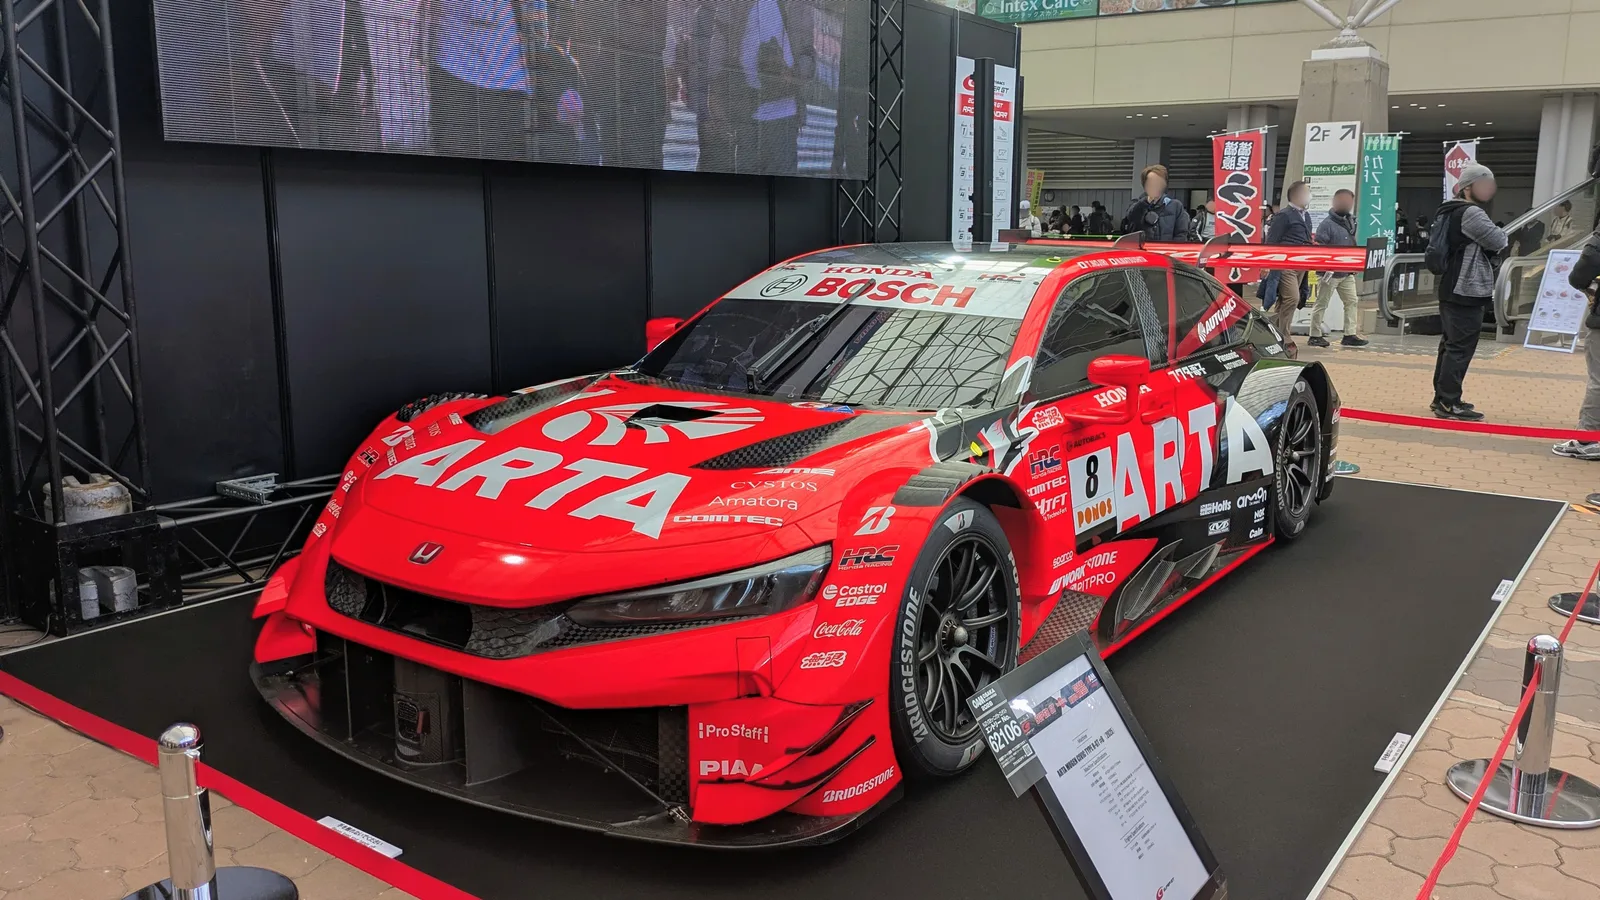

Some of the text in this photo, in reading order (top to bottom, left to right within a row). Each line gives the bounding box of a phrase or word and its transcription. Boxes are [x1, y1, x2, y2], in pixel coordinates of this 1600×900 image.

[1309, 125, 1331, 142] 2F
[1313, 165, 1330, 173] Intex
[1332, 164, 1348, 172] Cafe
[1366, 249, 1386, 270] ARTA
[820, 266, 934, 280] HONDA
[803, 277, 976, 309] BOSCH
[1206, 296, 1237, 335] AUTOBACS
[1094, 384, 1152, 408] HONA
[1074, 432, 1107, 448] AUTOBACS
[1028, 445, 1062, 476] HRC
[1115, 396, 1274, 534] ARTA
[754, 467, 836, 477] AME
[1085, 454, 1099, 499] 8
[373, 438, 691, 540] ARTA
[731, 481, 818, 492] CVSTOS
[708, 496, 798, 511] Amatora
[1212, 499, 1231, 514] Holts
[1237, 487, 1267, 509] amon
[674, 514, 784, 527] COMTEC
[1077, 497, 1113, 528] PONOS
[839, 544, 900, 566] HRC
[1053, 550, 1073, 567] sparco
[1062, 564, 1086, 588] WORK
[839, 583, 887, 597] Castrol
[835, 595, 880, 608] EDGE
[814, 618, 867, 639] Coca-Cola
[901, 587, 921, 744] BRIDGESTONE
[706, 724, 764, 741] Pro Staff
[988, 720, 1022, 753] 62106
[823, 765, 895, 803] BRIDGESTONE
